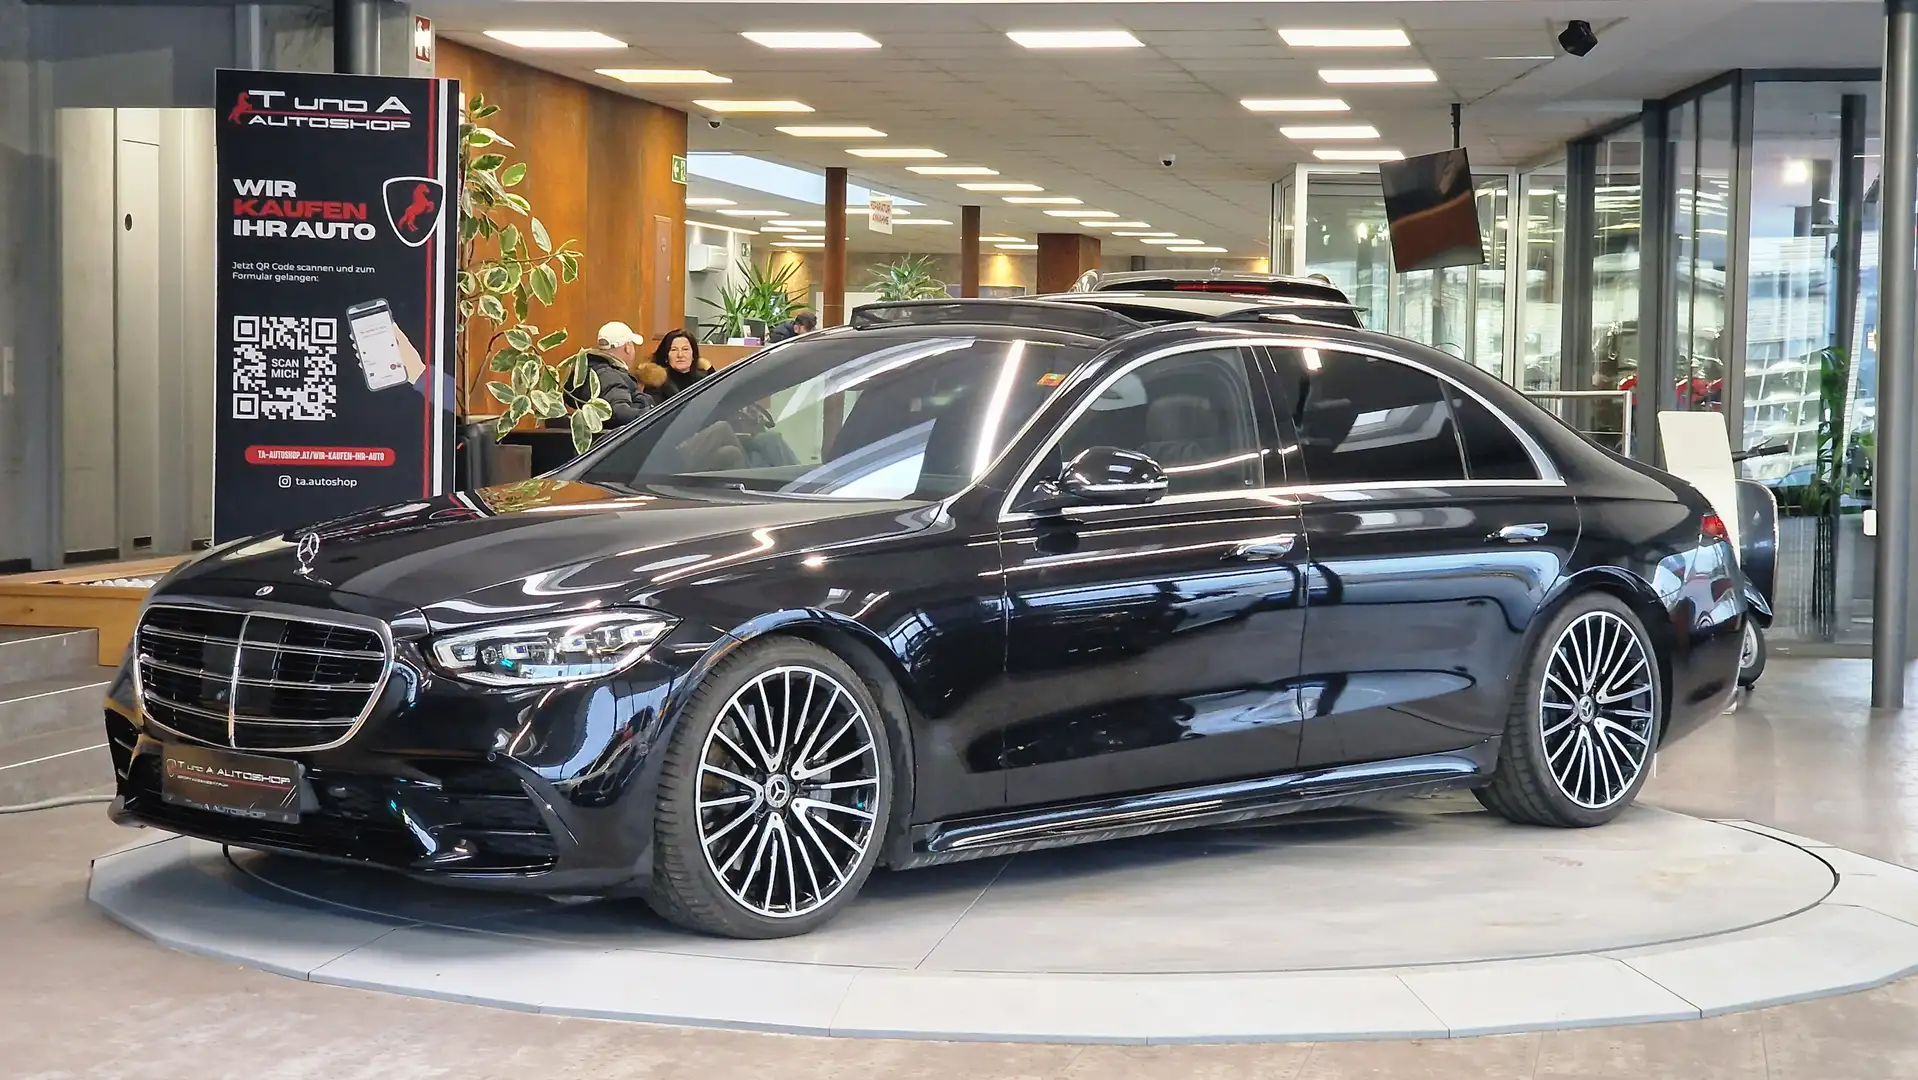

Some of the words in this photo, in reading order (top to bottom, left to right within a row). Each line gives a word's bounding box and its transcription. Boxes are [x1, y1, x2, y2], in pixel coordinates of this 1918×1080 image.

[248, 90, 285, 108] T
[376, 96, 412, 114] A
[248, 114, 411, 131] AUTOSHOP
[233, 178, 297, 198] WIR
[233, 199, 367, 219] KAUFEN
[233, 219, 291, 238] IHR
[291, 221, 376, 241] AUTO
[232, 261, 254, 270] Jetzt
[255, 262, 270, 271] QR
[272, 262, 295, 271] Code
[296, 263, 334, 272] scannen
[336, 264, 353, 273] und
[232, 272, 273, 280] Formular
[274, 273, 319, 283] gelangen:
[271, 358, 300, 368] SCAN
[271, 368, 299, 379] MICH
[257, 450, 385, 461] TA-AUTOSHOP.AT/WIR-KAUFEN-IHR-AUTO
[295, 477, 358, 488] ta.autoshop
[177, 760, 184, 768] T
[206, 766, 214, 775] A
[216, 767, 291, 784] AUTOSHOP
